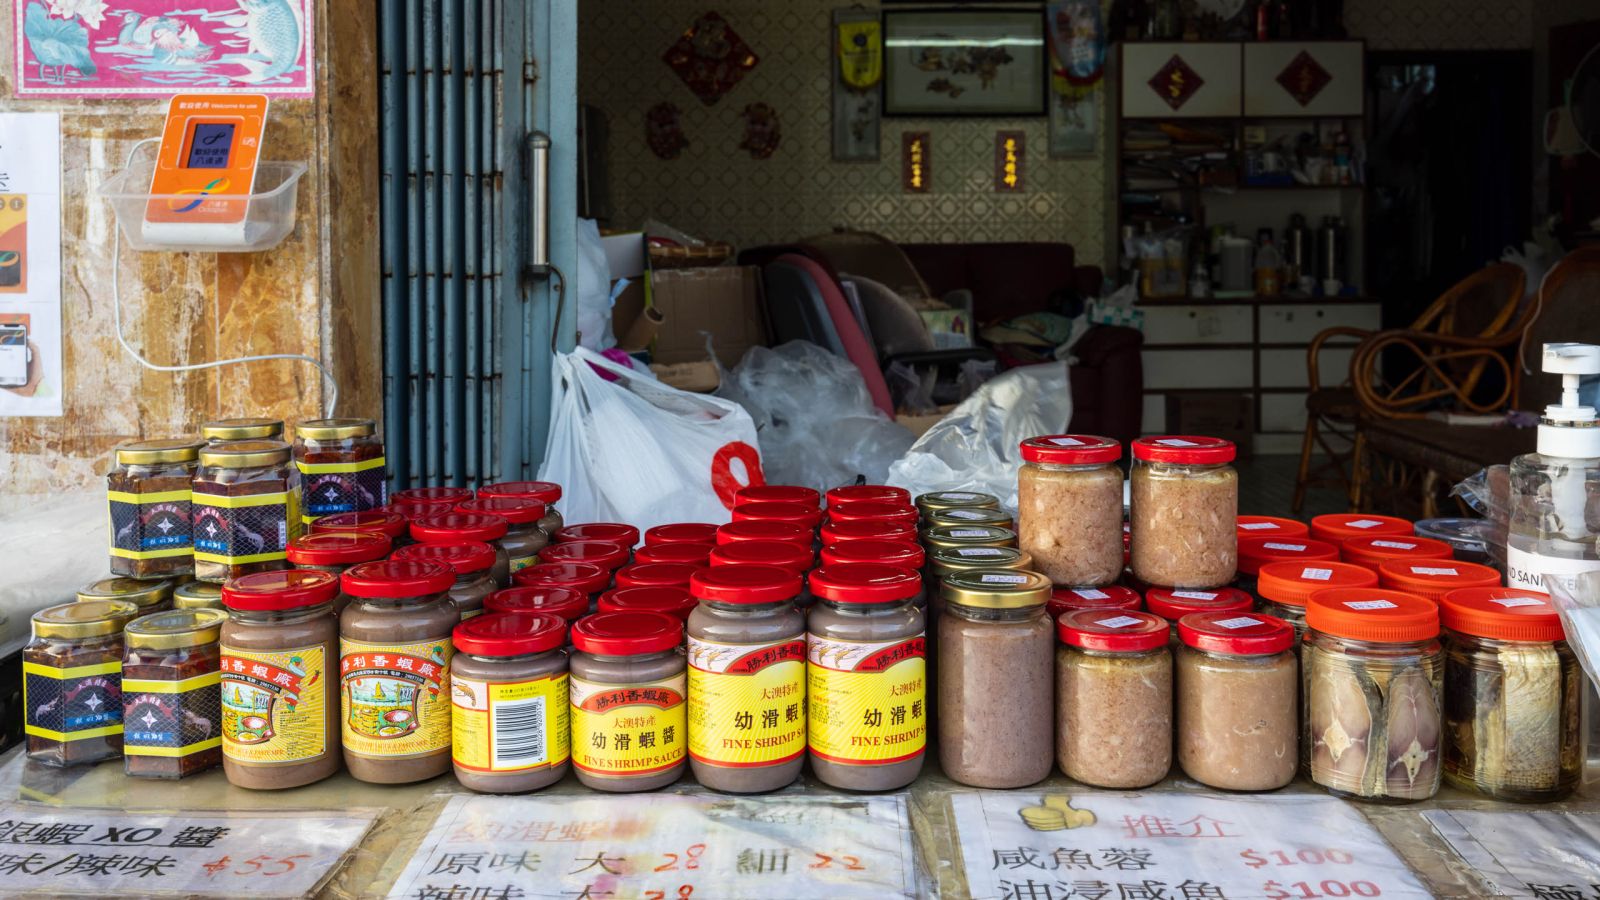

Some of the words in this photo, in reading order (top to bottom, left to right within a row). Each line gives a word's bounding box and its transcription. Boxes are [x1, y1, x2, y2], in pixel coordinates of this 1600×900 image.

[596, 689, 671, 709] 勝利香蝦廠
[592, 726, 675, 750] 幼滑蝦醬
[723, 738, 752, 749] FINE
[755, 731, 796, 748] SHRIMP
[851, 736, 880, 746] FINE
[883, 727, 920, 745] SHRIMP
[584, 755, 605, 769] FINE
[607, 757, 652, 768] SHRIMP
[654, 748, 682, 764] SAUCE
[1118, 814, 1235, 837] 推介
[92, 827, 163, 842] XO
[169, 826, 231, 847] 醬
[428, 850, 541, 875] 原味
[568, 851, 626, 875] 大
[653, 843, 706, 872] 28
[809, 851, 865, 870] 22
[992, 846, 1158, 870] 咸魚蓉
[1239, 848, 1354, 869] $100
[1263, 879, 1381, 900] $100
